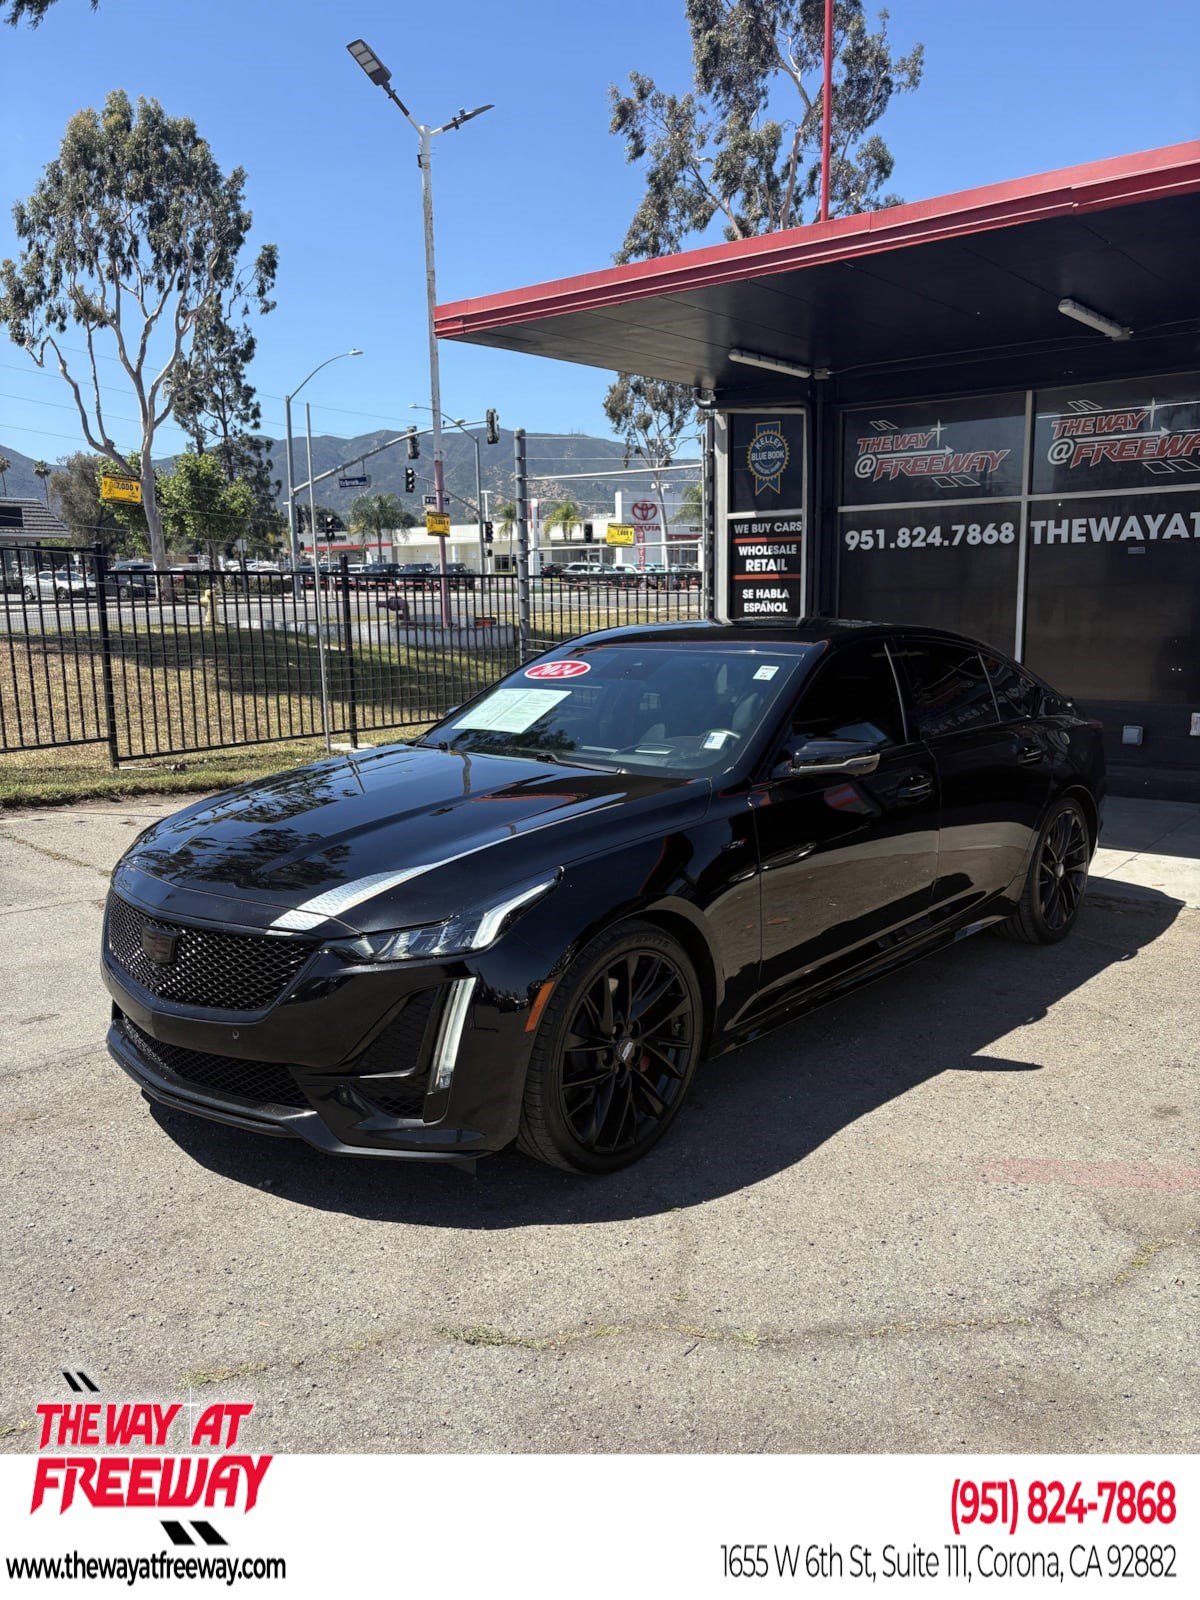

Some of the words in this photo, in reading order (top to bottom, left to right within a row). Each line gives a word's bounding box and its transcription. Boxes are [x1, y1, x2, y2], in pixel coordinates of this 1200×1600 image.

[1051, 417, 1096, 440] THE
[1096, 411, 1149, 433] WAY
[754, 435, 783, 450] KELLEY
[857, 437, 893, 456] THE
[893, 431, 936, 450] WAY
[751, 452, 768, 461] BLUE
[768, 450, 785, 460] BOOK
[854, 449, 1011, 482] @FREEWAY
[734, 523, 749, 534] WE
[751, 522, 771, 533] BUY
[774, 521, 802, 532] CARS
[844, 521, 1016, 551] 951.824.7868
[738, 544, 797, 556] WHOLESALE
[745, 558, 788, 572] RETAIL
[742, 588, 754, 599] SE
[756, 588, 790, 599] HABLA
